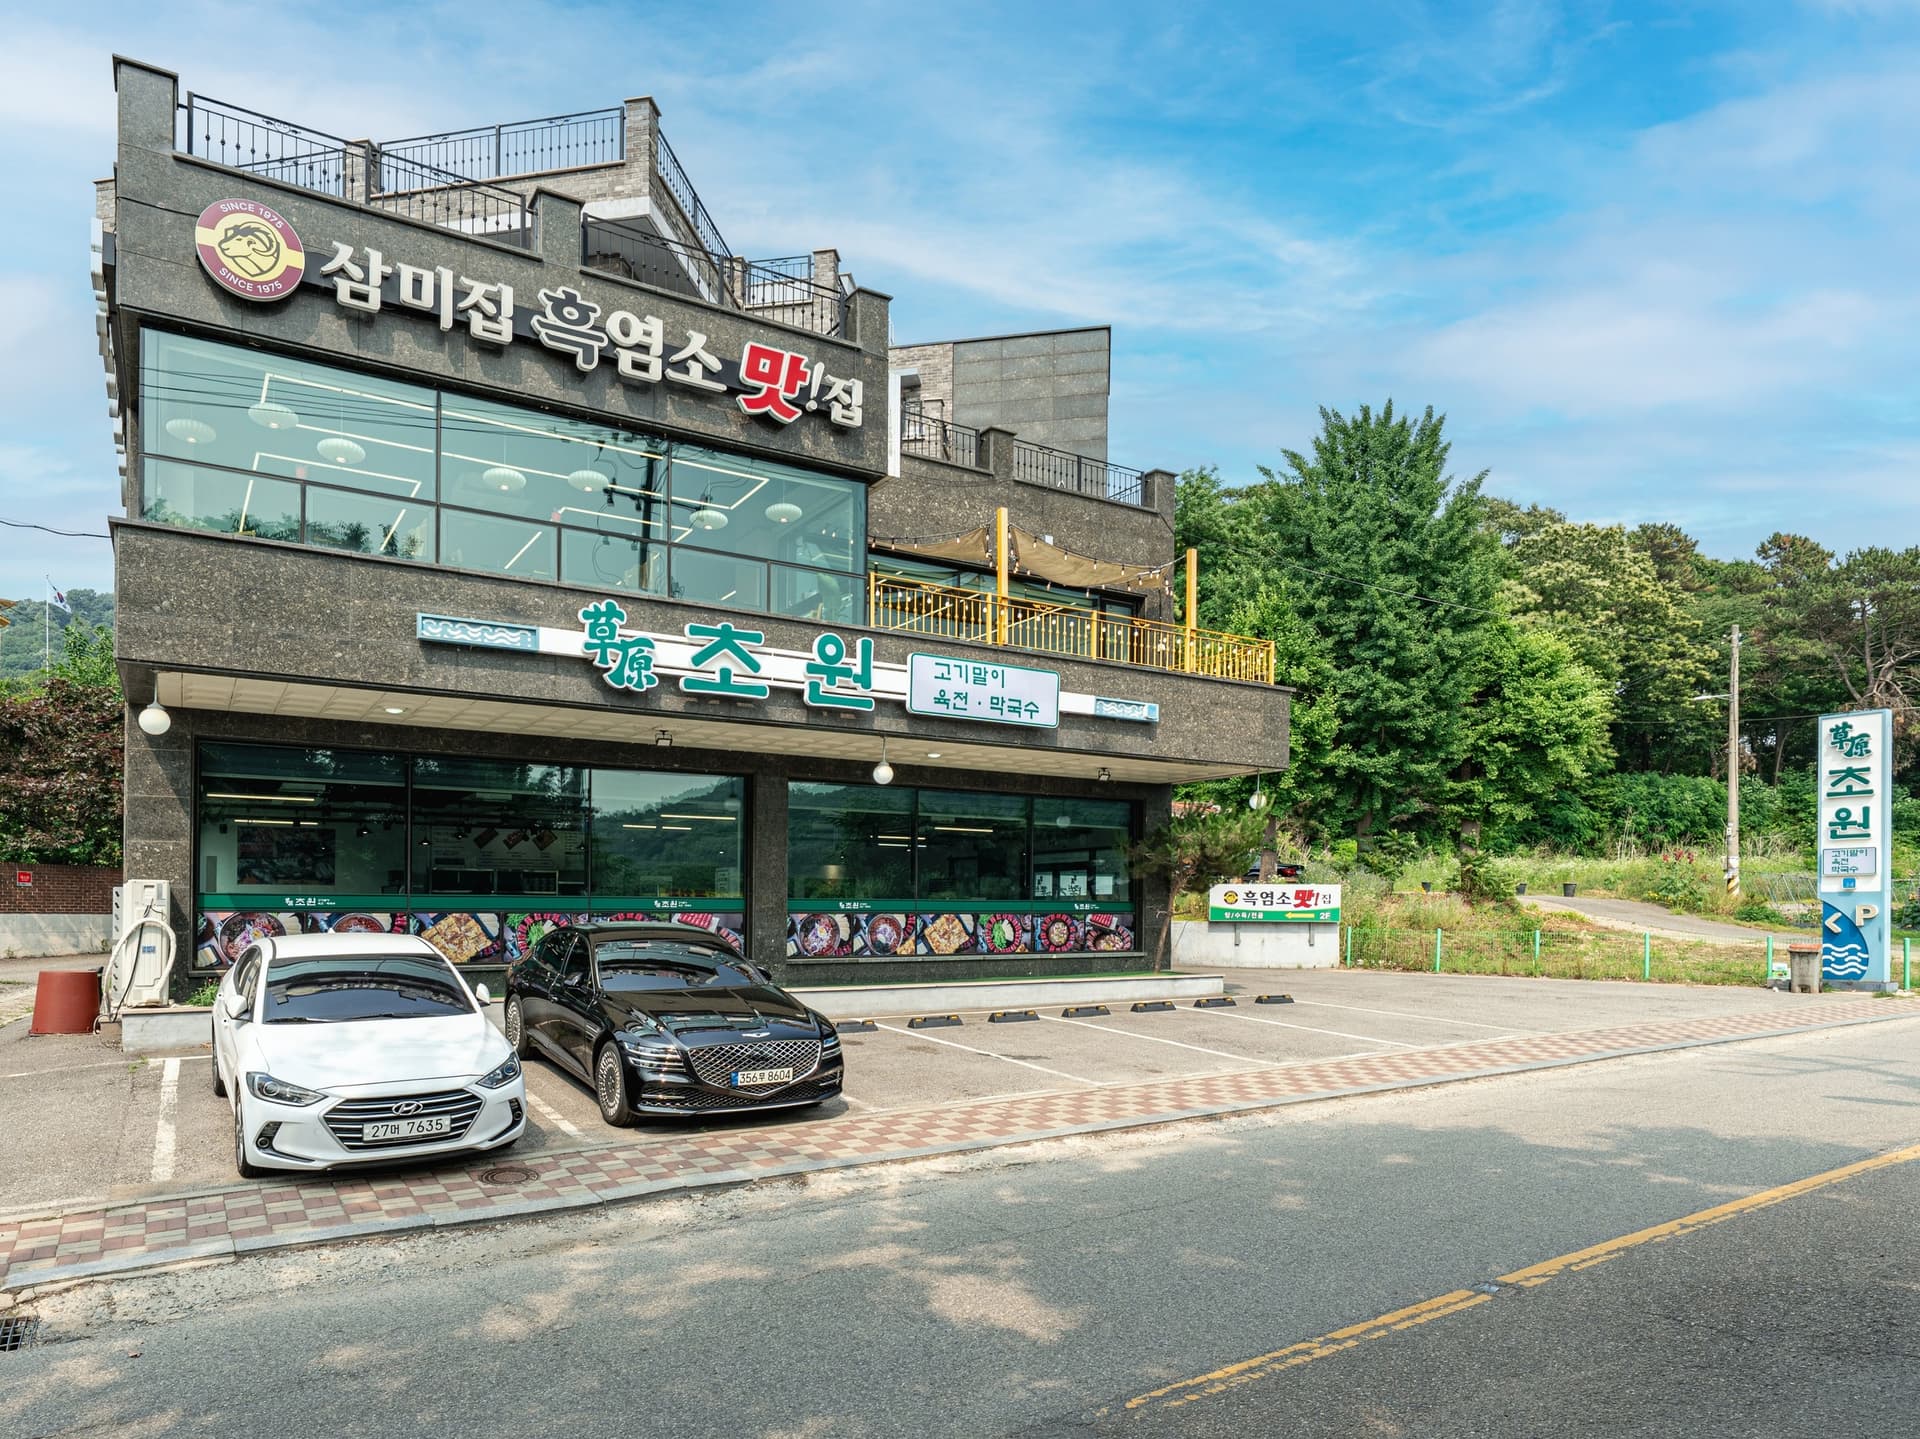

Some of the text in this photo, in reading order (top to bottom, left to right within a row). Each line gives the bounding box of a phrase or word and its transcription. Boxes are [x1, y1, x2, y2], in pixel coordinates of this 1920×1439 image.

[220, 202, 284, 229] SINCE 1975
[219, 267, 282, 294] SINCE 1975
[320, 240, 514, 345] 삼미집
[530, 286, 728, 393] 흑염소
[578, 600, 658, 691] 草原
[679, 622, 876, 711] 초원
[934, 662, 1005, 688] 고기말이
[933, 690, 1040, 719] 육전 막국수
[1829, 721, 1872, 757] 草原
[1826, 766, 1874, 840] 초원
[1831, 849, 1868, 857] 고기말이
[1831, 865, 1859, 873] 막국수
[1242, 890, 1292, 906] 흑염소
[1319, 912, 1331, 920] 2F
[1855, 905, 1878, 926] P
[767, 1070, 791, 1081] 8604
[407, 1118, 443, 1134] 7635
